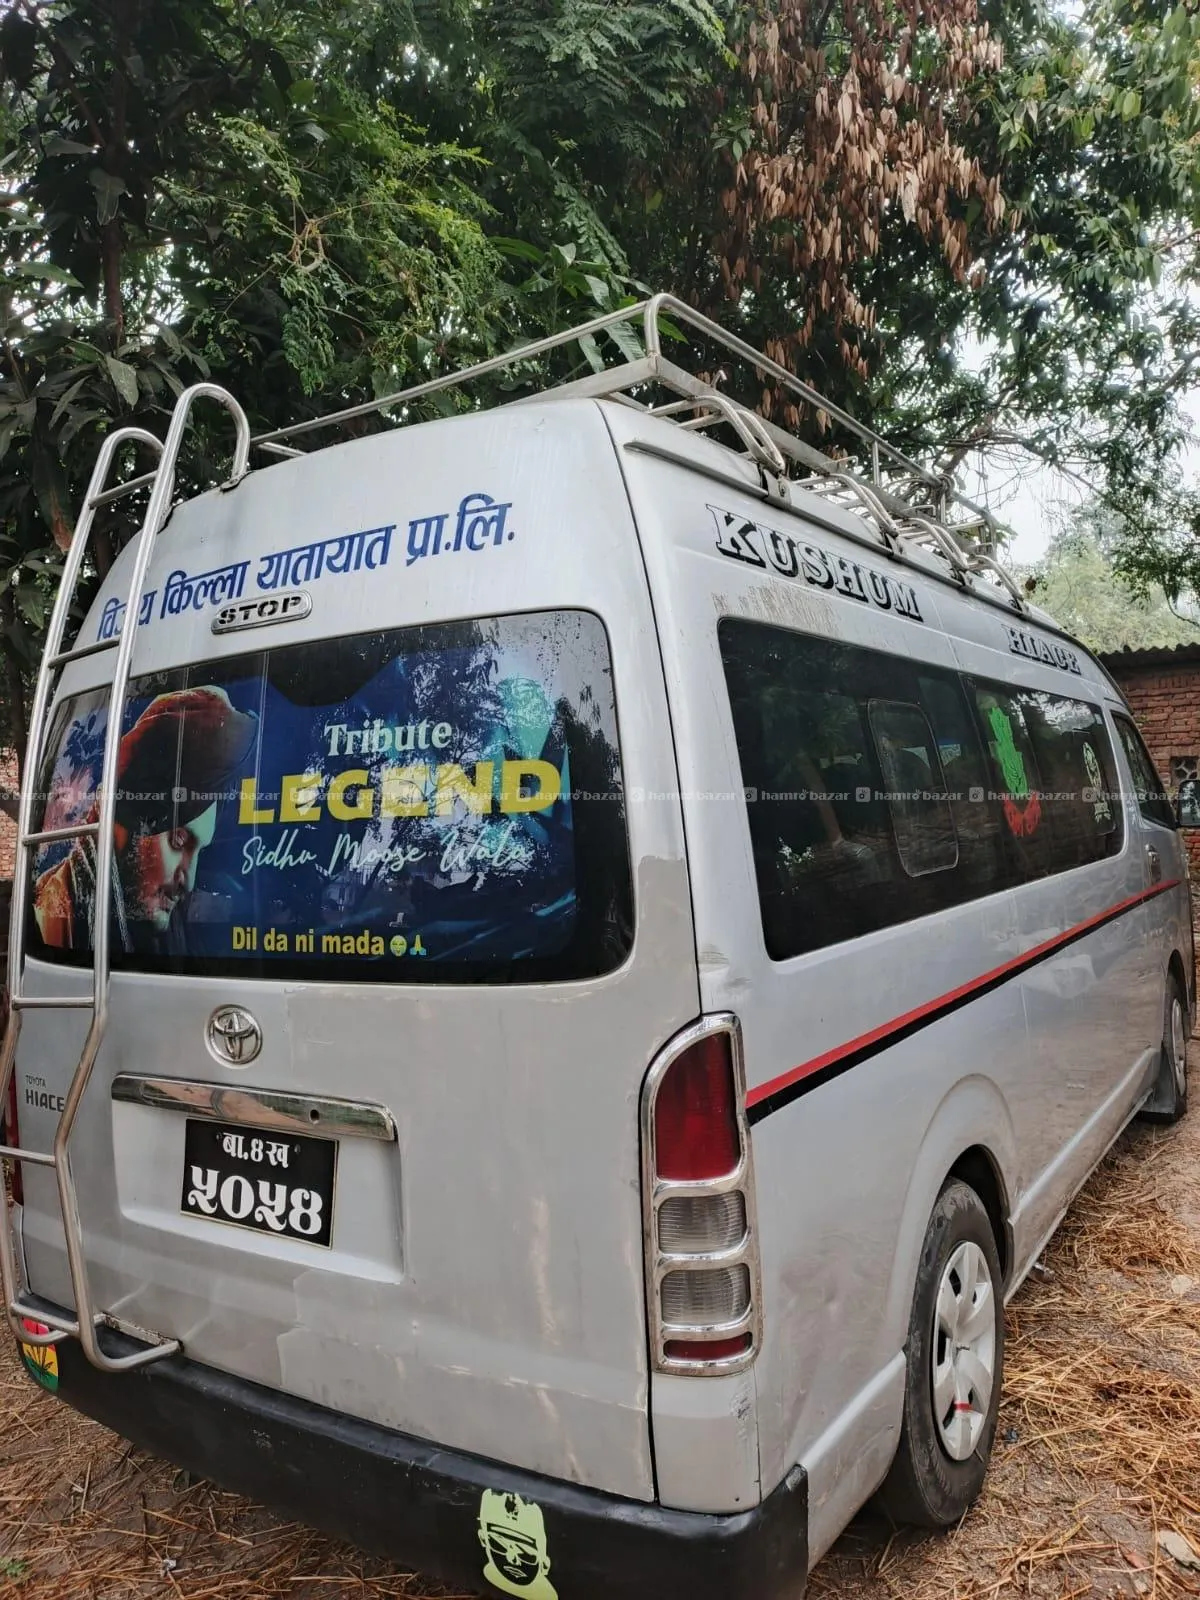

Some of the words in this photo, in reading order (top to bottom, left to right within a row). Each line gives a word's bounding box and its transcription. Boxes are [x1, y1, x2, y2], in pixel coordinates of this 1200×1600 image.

[96, 590, 158, 642] विय
[256, 524, 397, 591] यातायात
[405, 493, 516, 567] प्रा.लि.
[706, 504, 924, 622] KUSHUM
[217, 595, 302, 626] STOP
[1002, 624, 1082, 675] HIACE
[323, 719, 453, 757] Tribute
[238, 759, 562, 825] LEGEND
[242, 829, 317, 875] Sidhu
[232, 926, 258, 951] Dil
[263, 927, 288, 952] da
[295, 928, 315, 953] ni
[321, 929, 385, 956] mada
[25, 1074, 47, 1088] TOYOTA
[25, 1088, 66, 1113] HIACE
[187, 1164, 323, 1235] ५०५४
